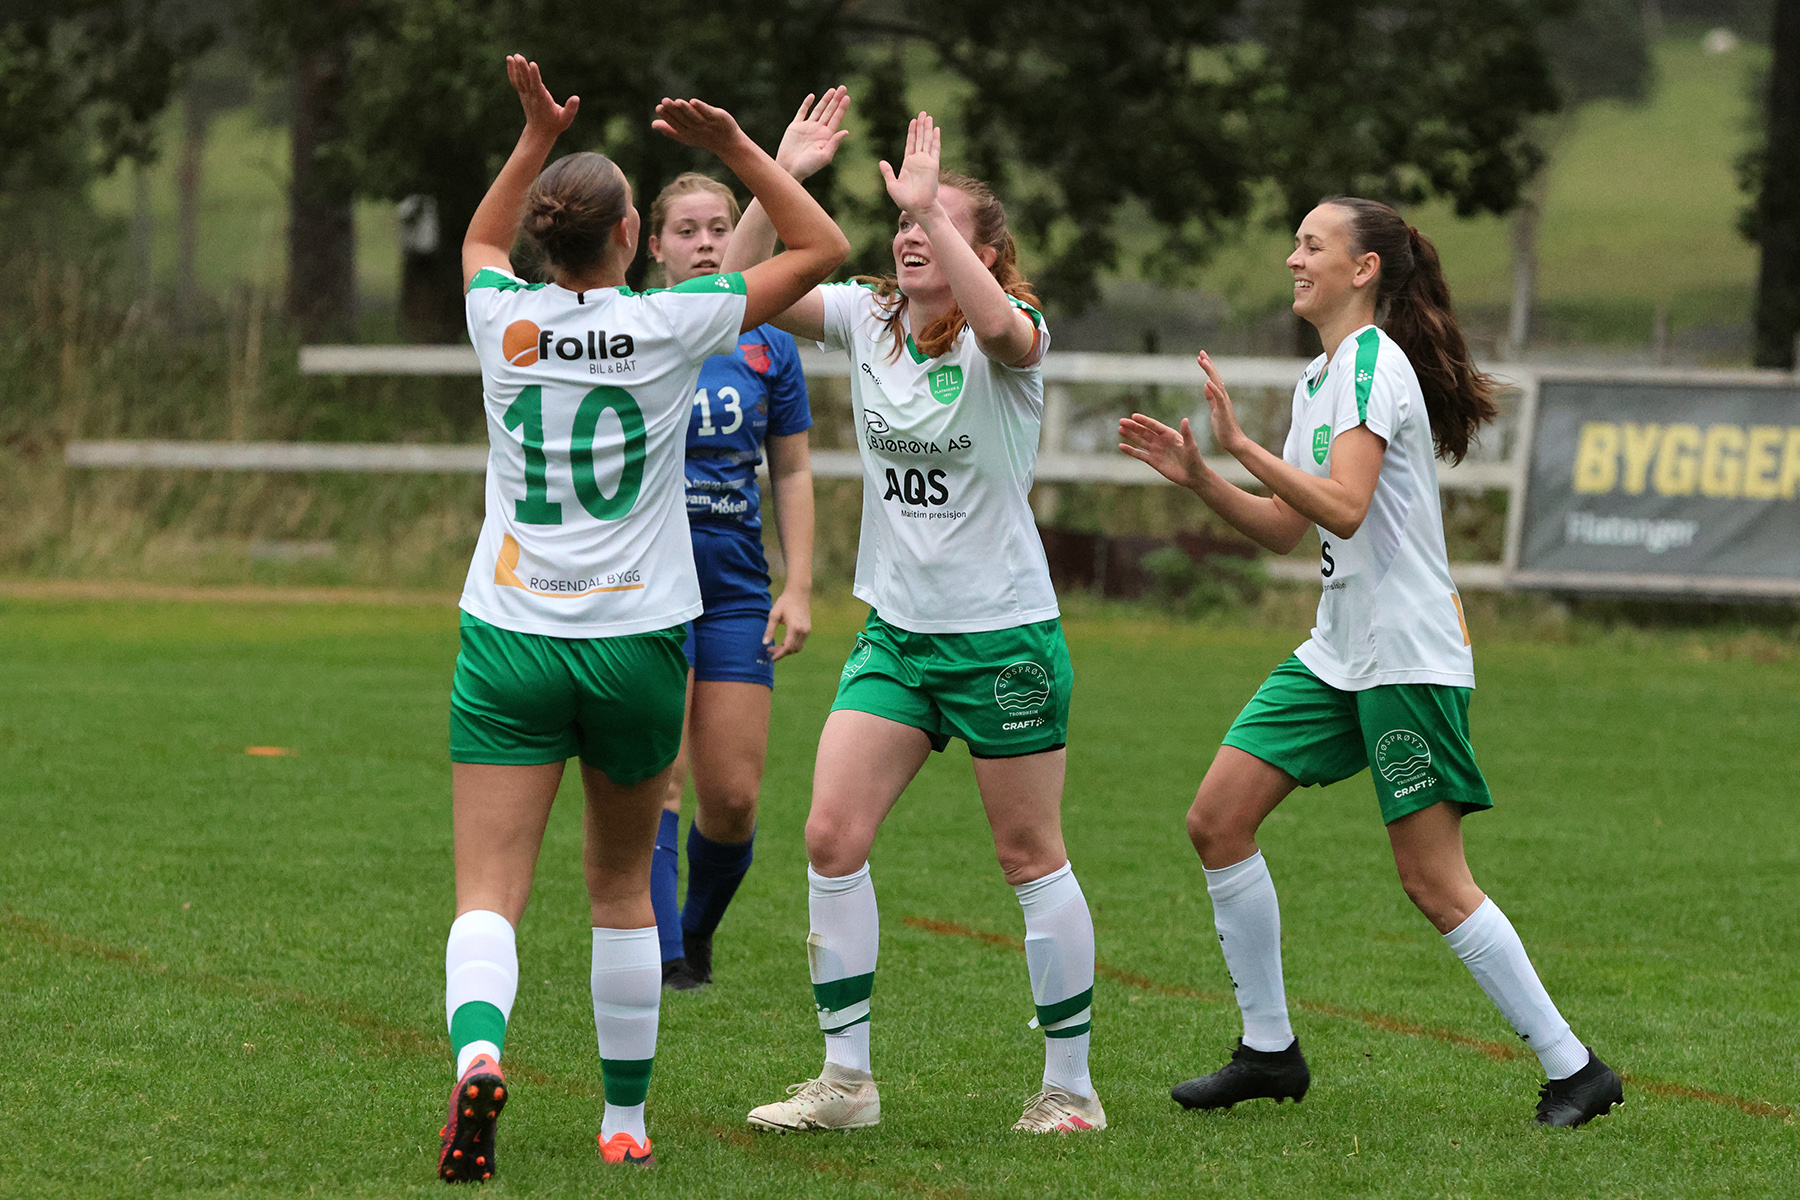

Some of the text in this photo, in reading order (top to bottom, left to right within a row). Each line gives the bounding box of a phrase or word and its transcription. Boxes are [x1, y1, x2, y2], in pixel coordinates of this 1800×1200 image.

[539, 330, 635, 361] folla
[589, 358, 637, 374] BIL & BÅT
[936, 371, 958, 387] FIL
[693, 386, 743, 436] 13
[502, 385, 647, 525] 10
[870, 434, 972, 454] BJØRØYA AS
[883, 468, 949, 508] AQS
[929, 510, 967, 520] presisjon
[529, 569, 641, 592] ROSENDAL BYGG
[999, 665, 1045, 689] SJØSPRØYT
[1002, 719, 1036, 731] CRAFT
[1379, 733, 1423, 761] SJØSPRØYT
[1394, 780, 1427, 798] CRAFT
